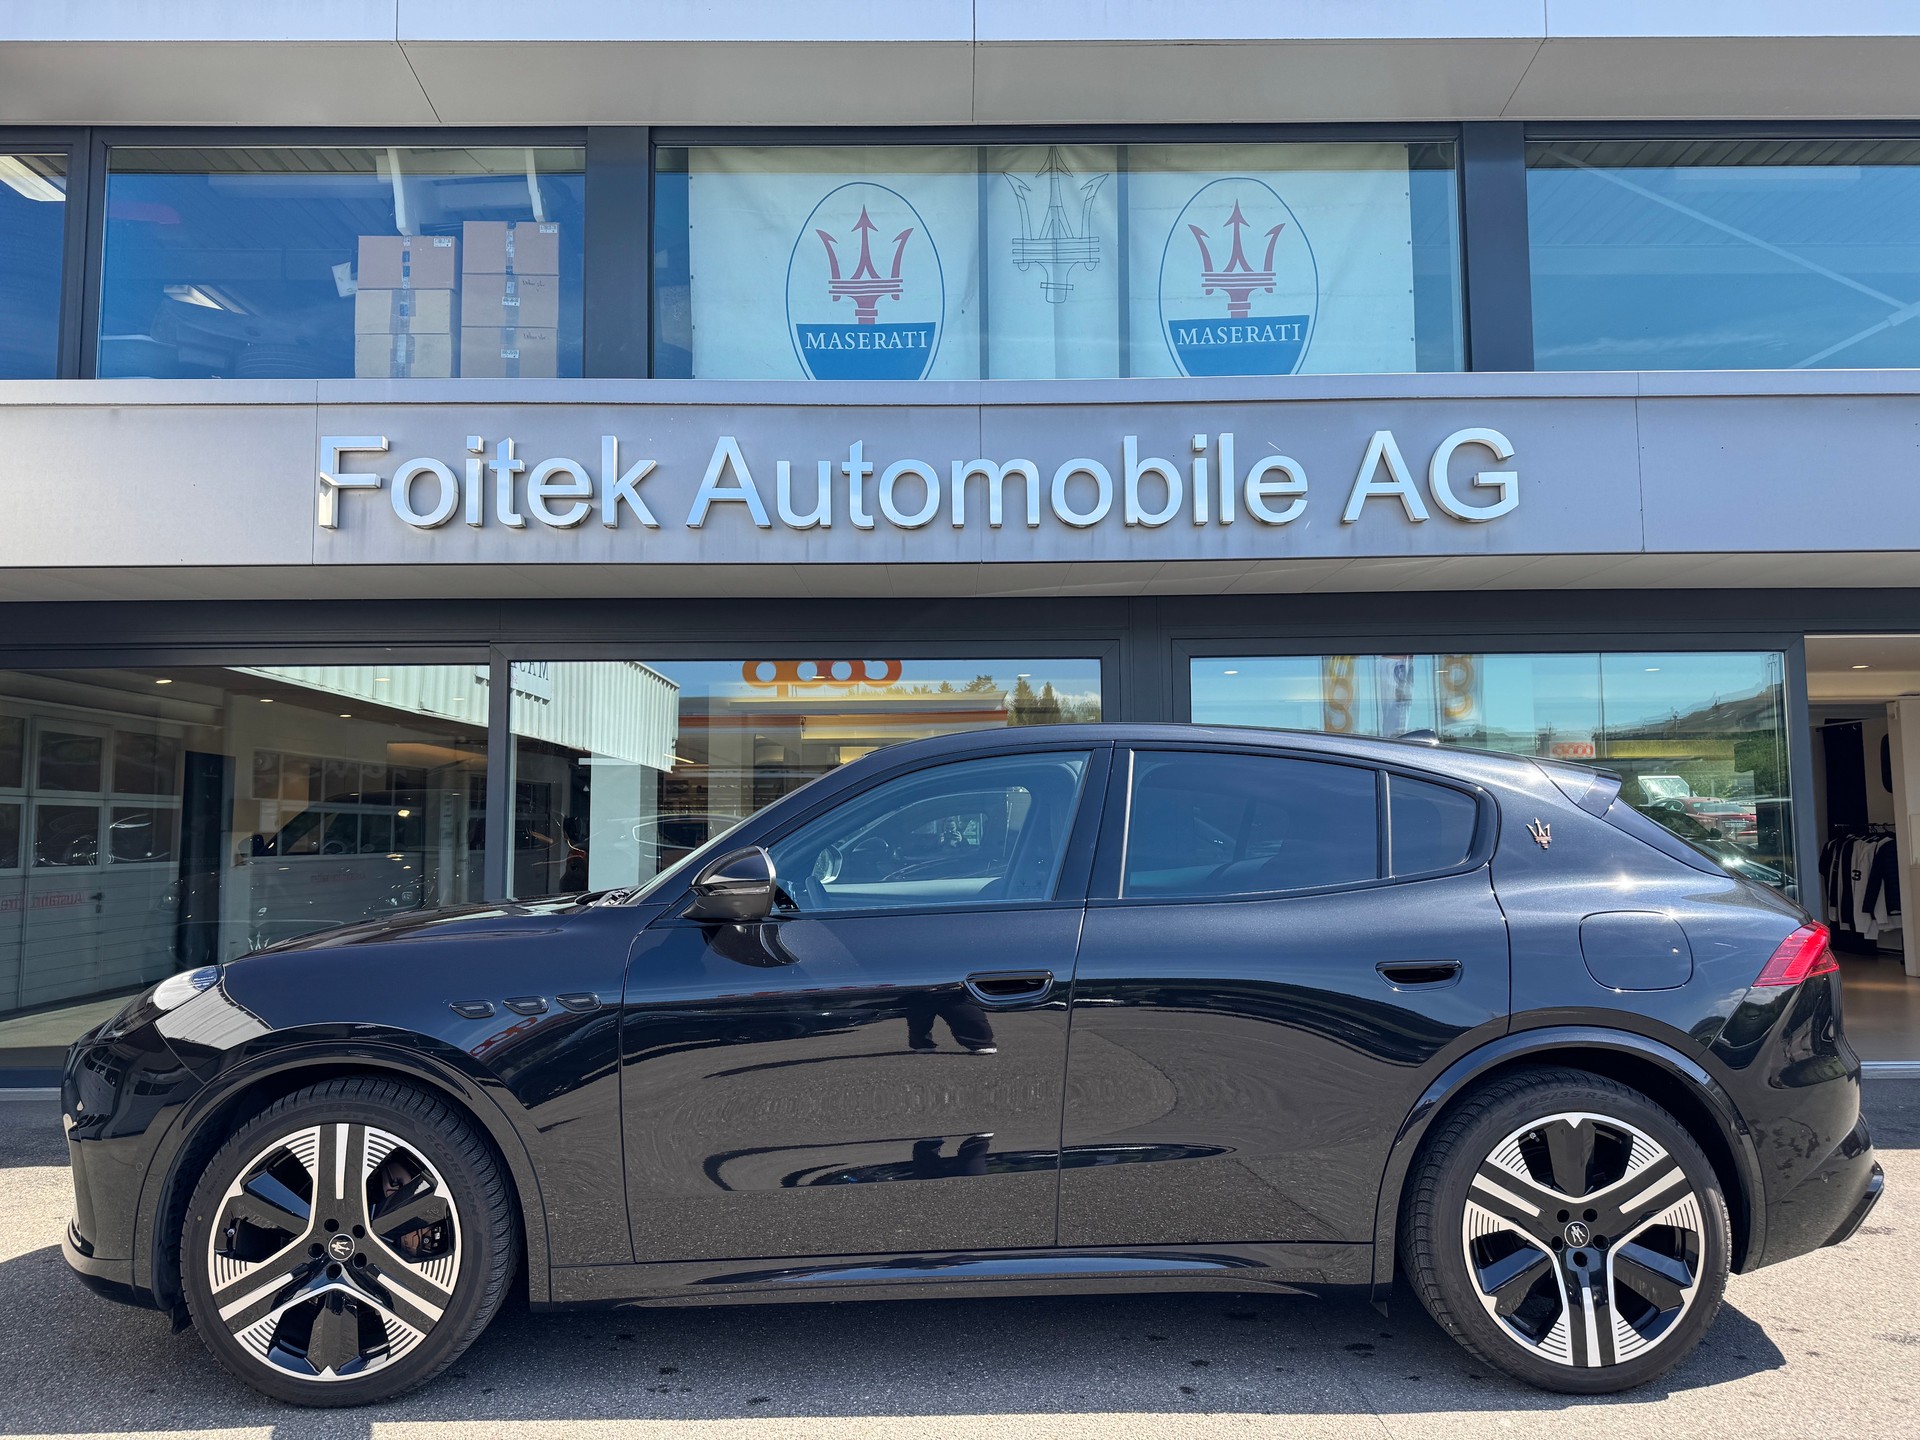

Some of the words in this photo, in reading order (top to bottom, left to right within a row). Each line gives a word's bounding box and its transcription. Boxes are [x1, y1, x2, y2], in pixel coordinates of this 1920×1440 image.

[805, 331, 928, 351] MASERATI
[1177, 322, 1302, 346] MASERATI
[319, 435, 660, 529] Foitek
[685, 432, 1309, 530] Automobile
[1341, 427, 1520, 524] AG
